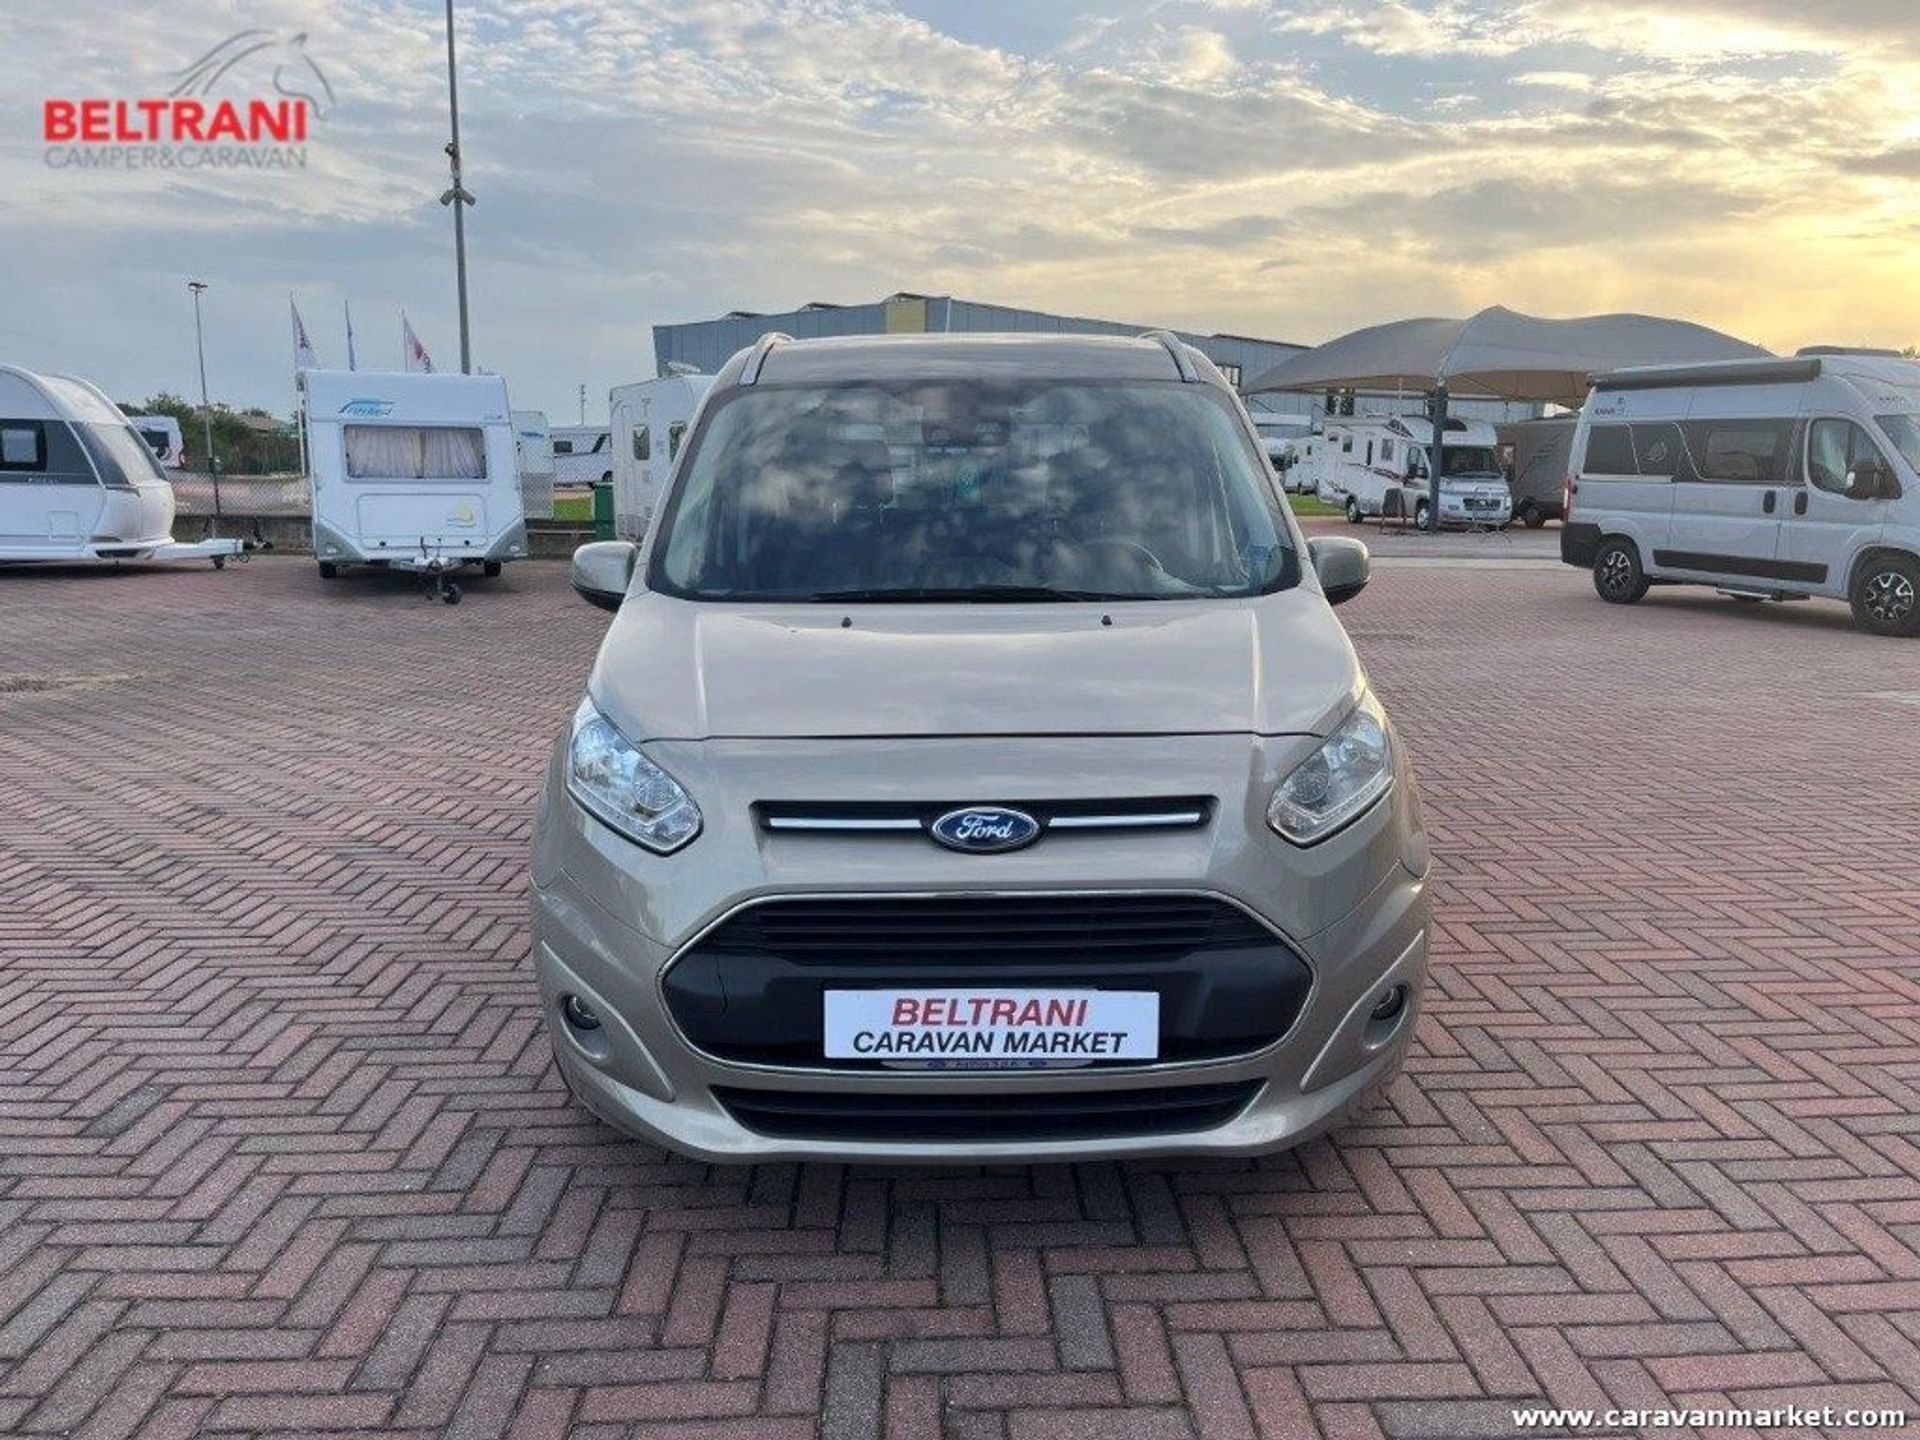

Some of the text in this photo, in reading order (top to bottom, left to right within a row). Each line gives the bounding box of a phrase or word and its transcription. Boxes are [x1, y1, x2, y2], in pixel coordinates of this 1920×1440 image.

[956, 813, 1014, 839] Ford
[891, 998, 1088, 1027] BELTRANI
[853, 1031, 1127, 1054] CARAVAN MARKET
